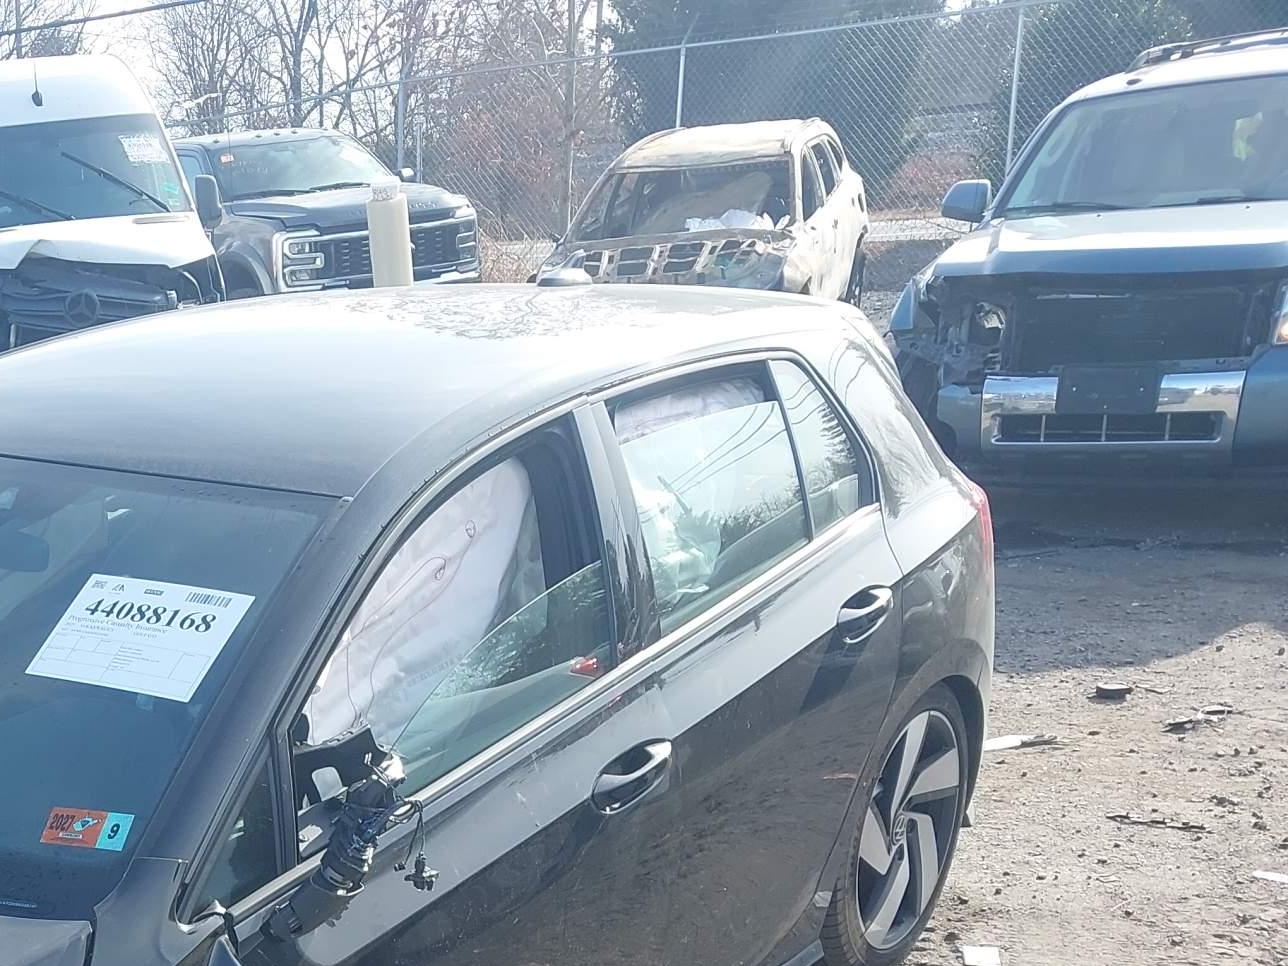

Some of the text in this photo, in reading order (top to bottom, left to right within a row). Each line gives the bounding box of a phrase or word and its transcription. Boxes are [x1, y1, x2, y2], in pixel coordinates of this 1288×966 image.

[84, 597, 217, 634] 44088168
[49, 813, 76, 832] 2027
[107, 822, 121, 840] 9
